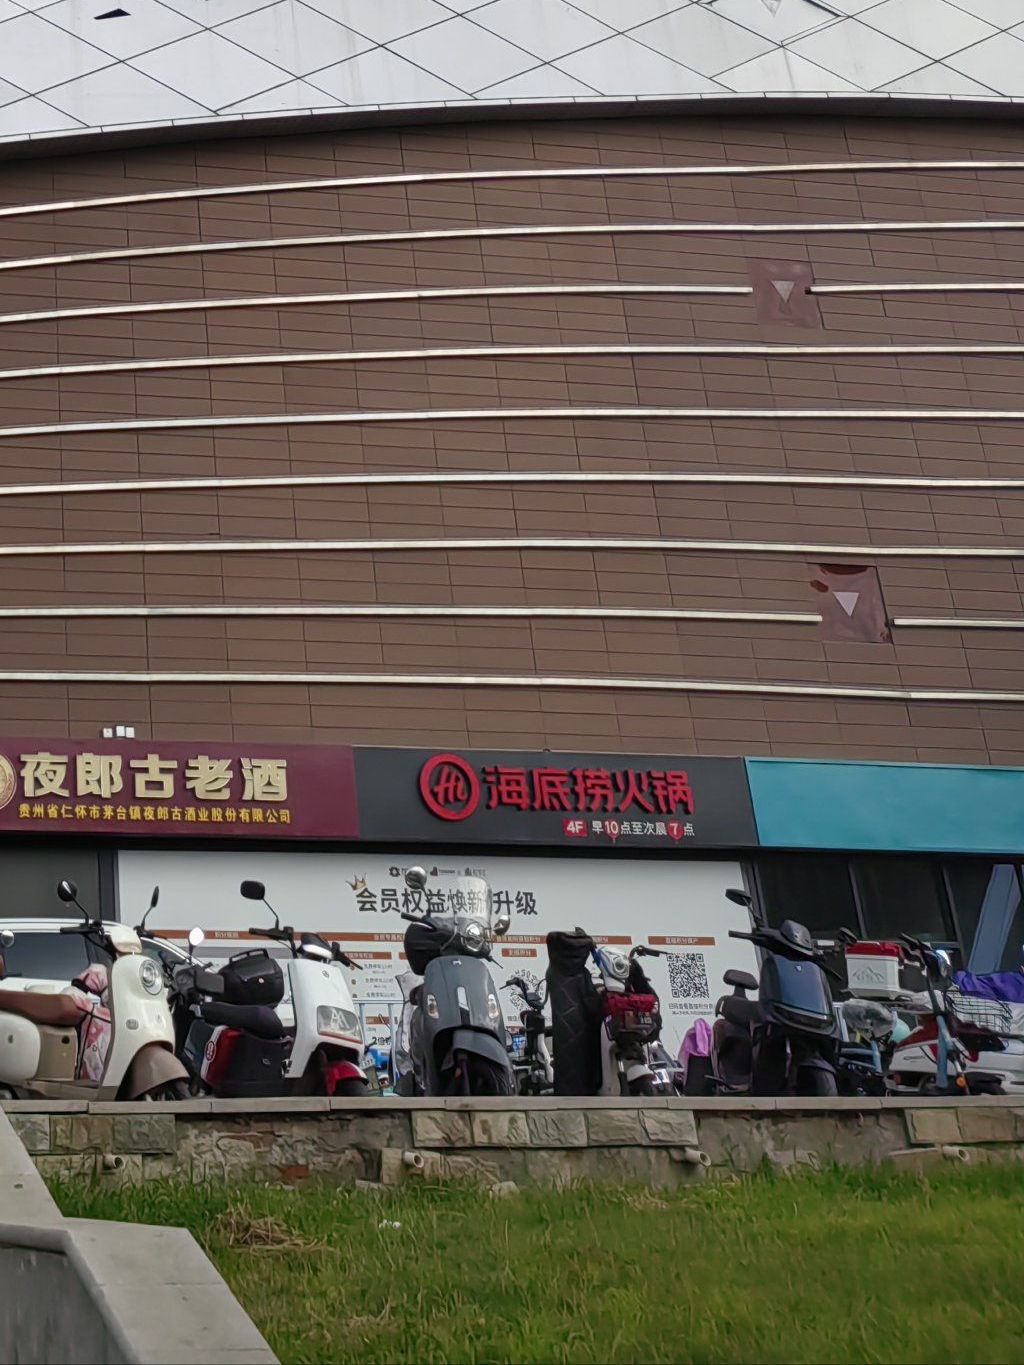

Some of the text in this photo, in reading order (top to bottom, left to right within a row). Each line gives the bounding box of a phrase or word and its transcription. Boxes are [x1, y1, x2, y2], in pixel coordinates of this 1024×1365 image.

[19, 751, 289, 802] 夜郎古老酒
[483, 765, 696, 815] 海底捞火锅
[18, 802, 292, 825] 贵州省仁怀市茅台镇夜郎古酒业股份有限公司
[565, 820, 585, 836] 4F
